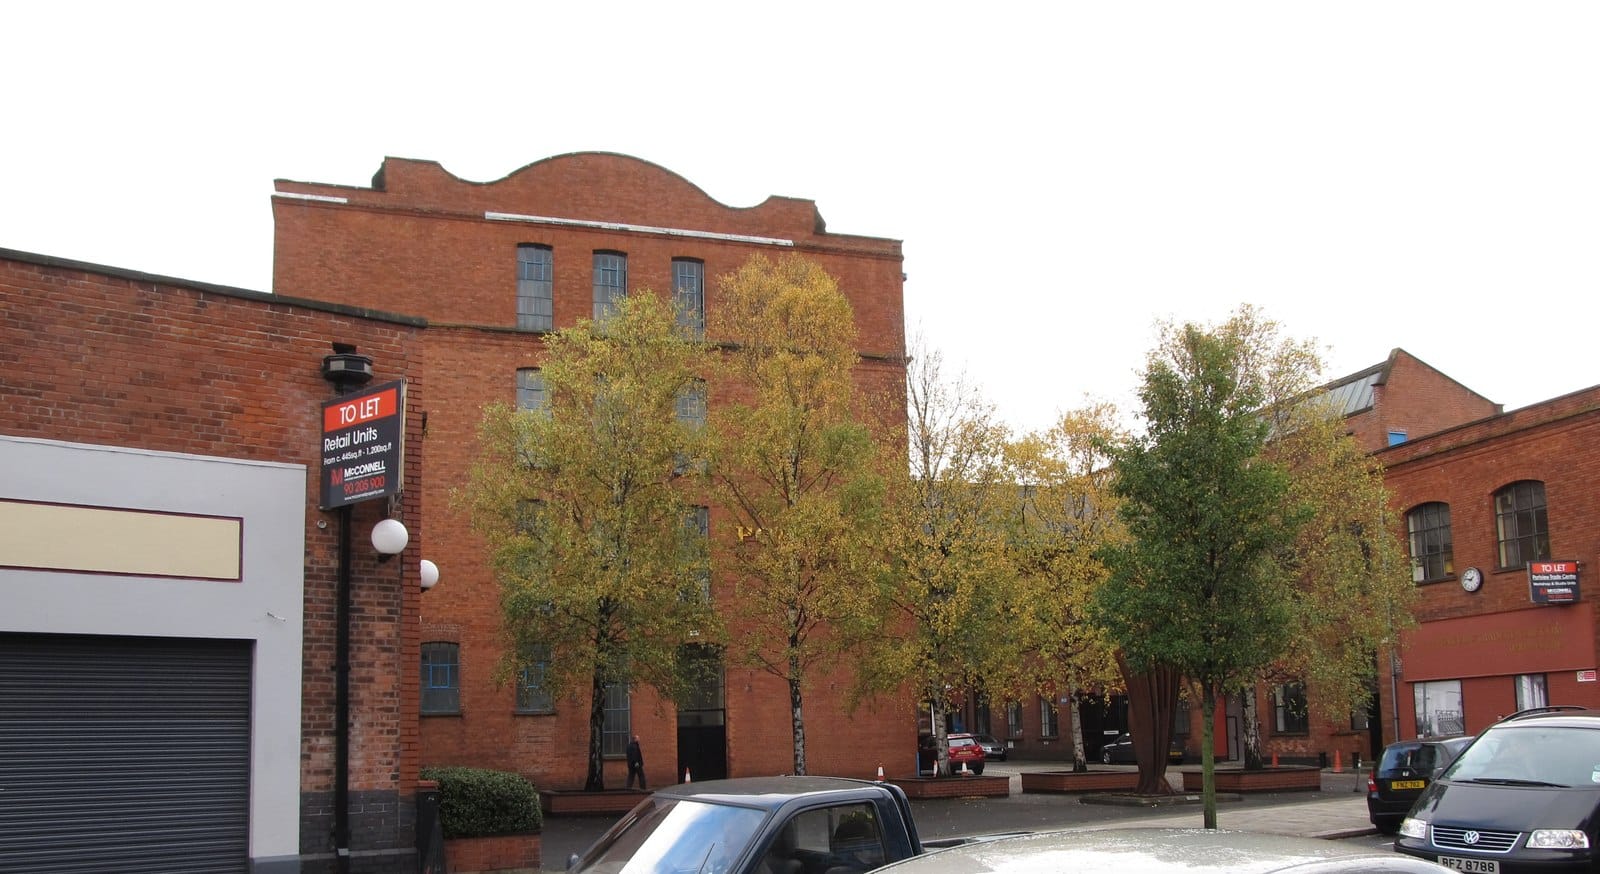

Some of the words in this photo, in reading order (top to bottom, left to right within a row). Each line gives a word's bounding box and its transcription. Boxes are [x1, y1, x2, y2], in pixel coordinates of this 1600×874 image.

[340, 404, 356, 424] TO
[360, 397, 380, 419] LET
[324, 432, 351, 452] Retail
[353, 427, 378, 444] Units
[323, 457, 335, 466] From
[331, 467, 343, 487] M
[344, 460, 386, 477] McCONNELL
[343, 482, 354, 495] 90
[354, 479, 369, 492] 205
[370, 475, 385, 488] 900
[1542, 564, 1552, 572] TO
[1553, 564, 1565, 572] LET
[1465, 860, 1495, 873] 8788
